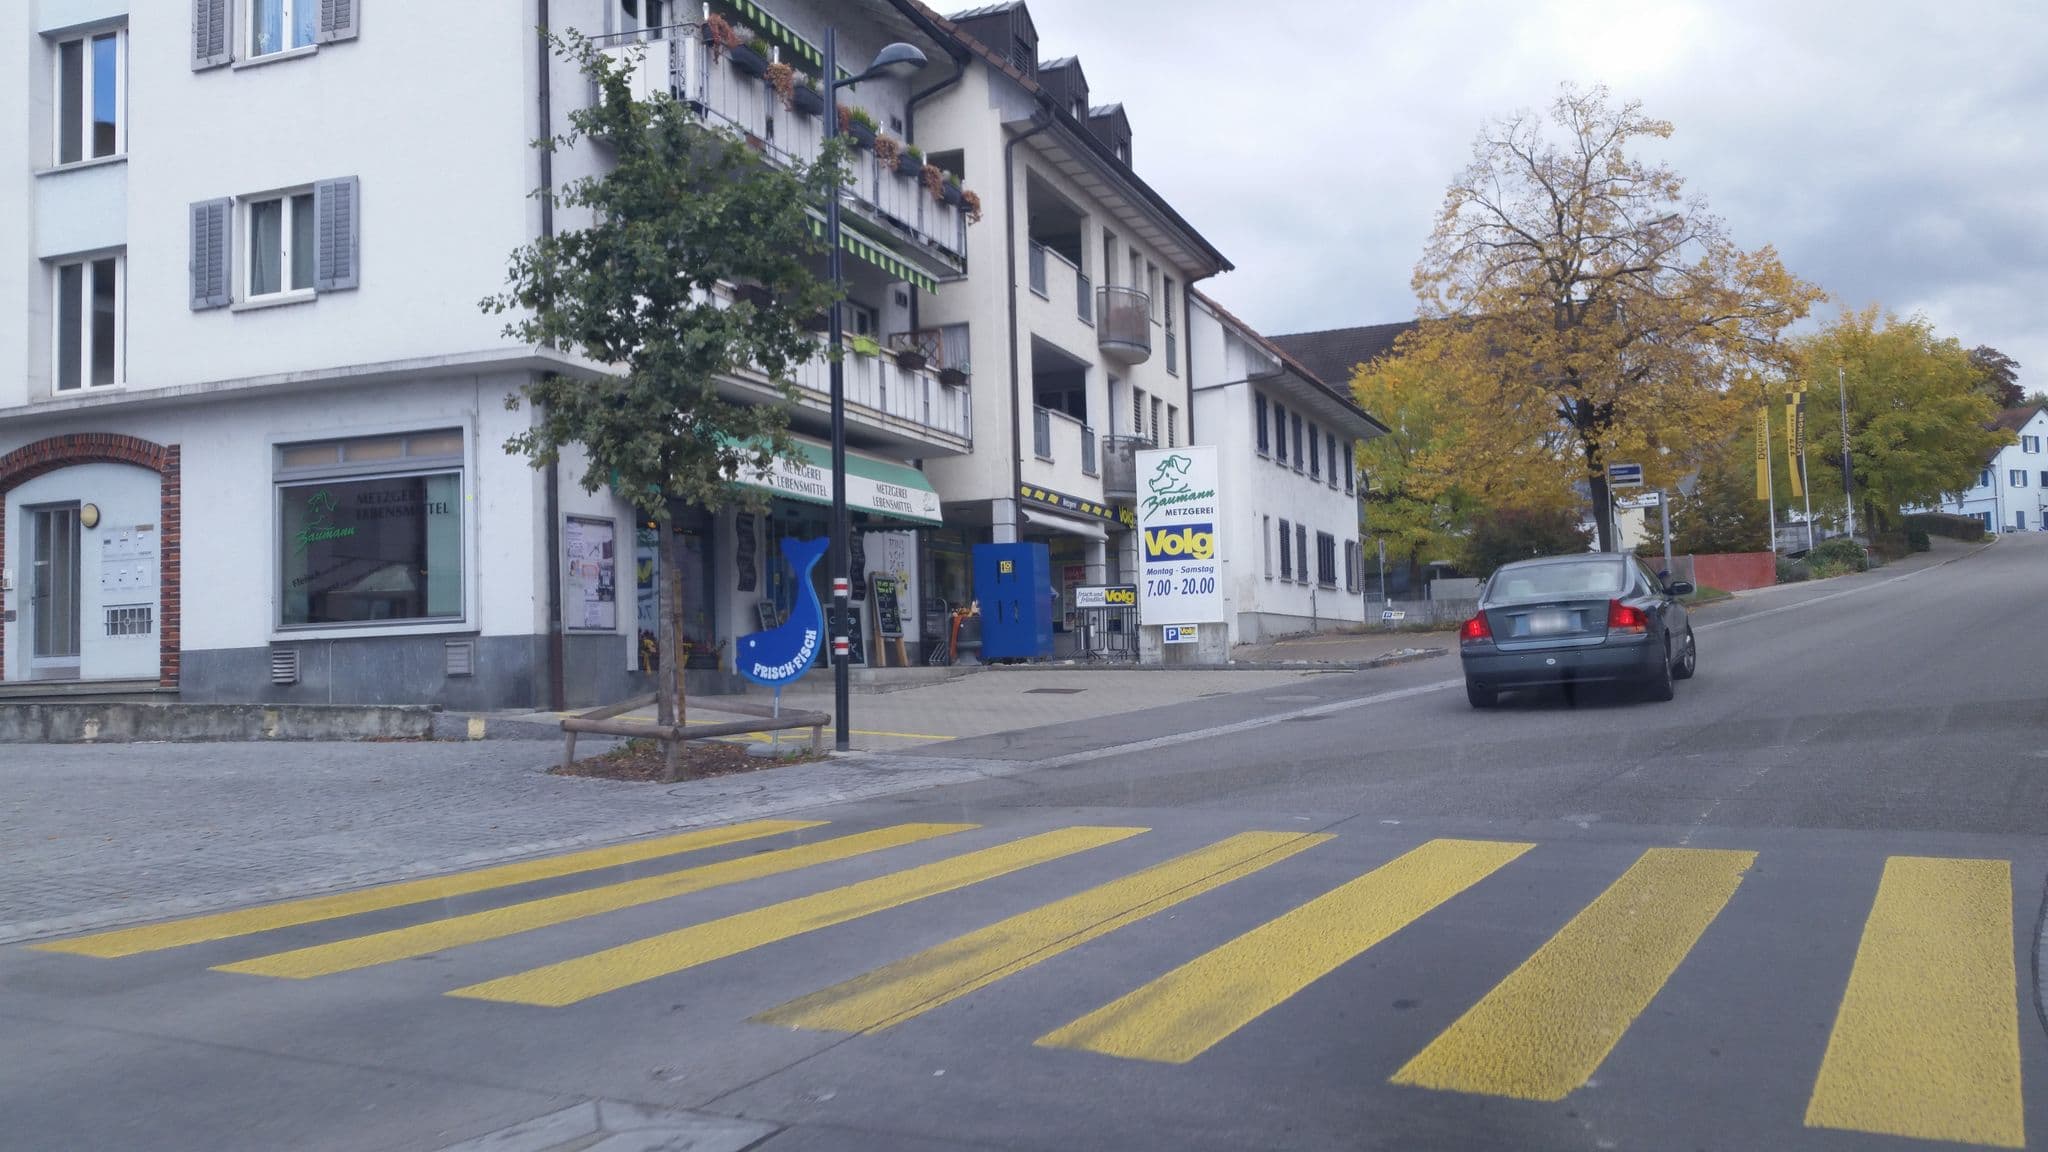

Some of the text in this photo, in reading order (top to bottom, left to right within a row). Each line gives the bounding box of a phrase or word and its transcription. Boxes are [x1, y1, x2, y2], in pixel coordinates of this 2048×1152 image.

[782, 461, 821, 481] METZGEREI
[357, 487, 428, 504] METZGERI
[776, 476, 827, 497] LEBENSMITTEL
[876, 483, 908, 499] METZGEREI
[357, 501, 449, 521] LEBENSMTEL
[872, 496, 913, 513] LEBENSMITTEL
[1165, 507, 1214, 517] METZGEREI
[1119, 506, 1134, 529] Volg
[1145, 528, 1214, 560] Volg
[1146, 567, 1173, 576] Montag
[1180, 566, 1214, 575] Samstag
[1147, 580, 1171, 597] 7.00
[1181, 577, 1215, 595] 20.00
[1105, 590, 1135, 606] Volg
